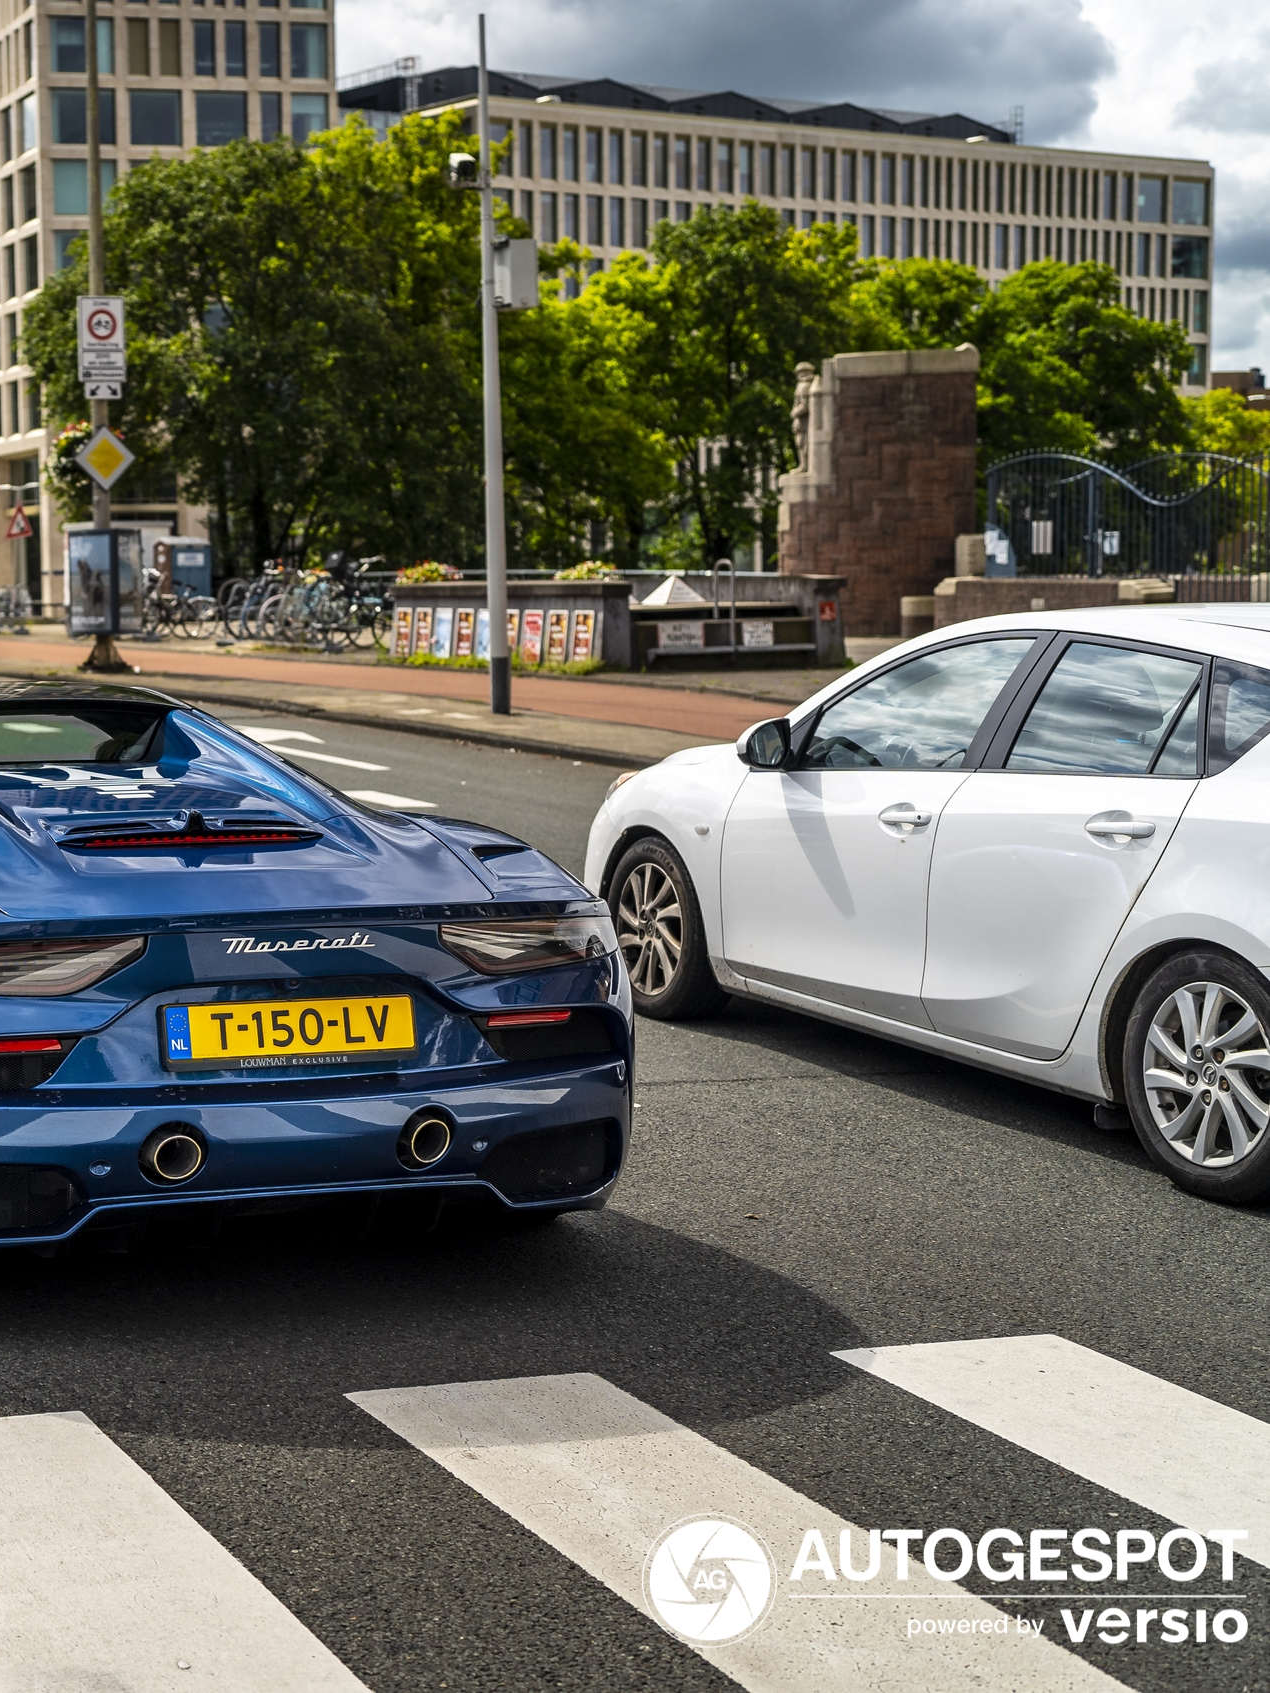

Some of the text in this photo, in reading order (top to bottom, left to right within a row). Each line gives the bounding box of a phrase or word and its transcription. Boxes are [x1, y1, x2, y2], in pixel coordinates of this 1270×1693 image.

[221, 932, 375, 954] Maserati
[210, 1005, 389, 1050] T-150-LV
[171, 1038, 189, 1051] NL
[240, 1055, 348, 1068] LOUWMAN EXCLUSIVE
